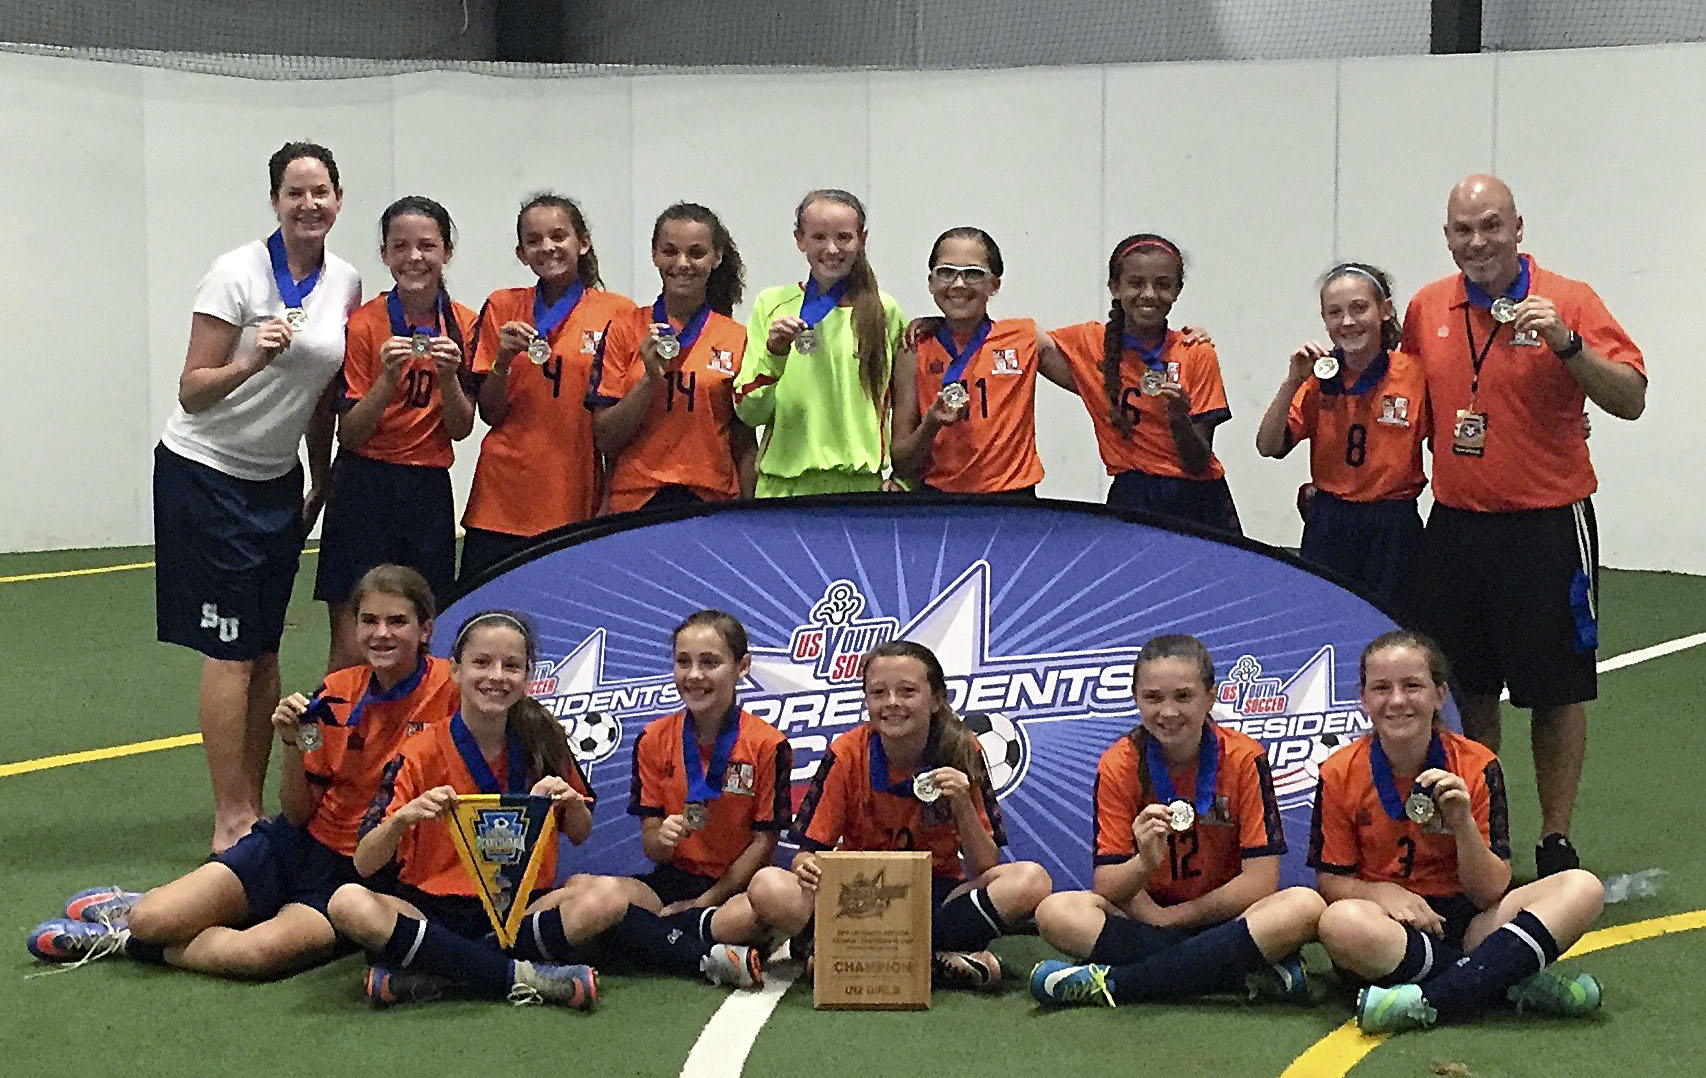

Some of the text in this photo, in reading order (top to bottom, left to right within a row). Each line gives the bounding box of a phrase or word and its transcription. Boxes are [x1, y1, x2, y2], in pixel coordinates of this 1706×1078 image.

[543, 354, 562, 398] 4
[663, 371, 696, 412] 14
[1345, 423, 1367, 467] 8
[200, 602, 240, 642] SU
[796, 626, 890, 674] US YOUTH
[538, 682, 682, 717] SIDENTS
[741, 664, 1136, 731] PREDENTS
[1222, 682, 1276, 710] US YOUTH
[1244, 697, 1285, 714] SOCCER
[1167, 832, 1202, 880] 12
[1392, 837, 1415, 878] 3
